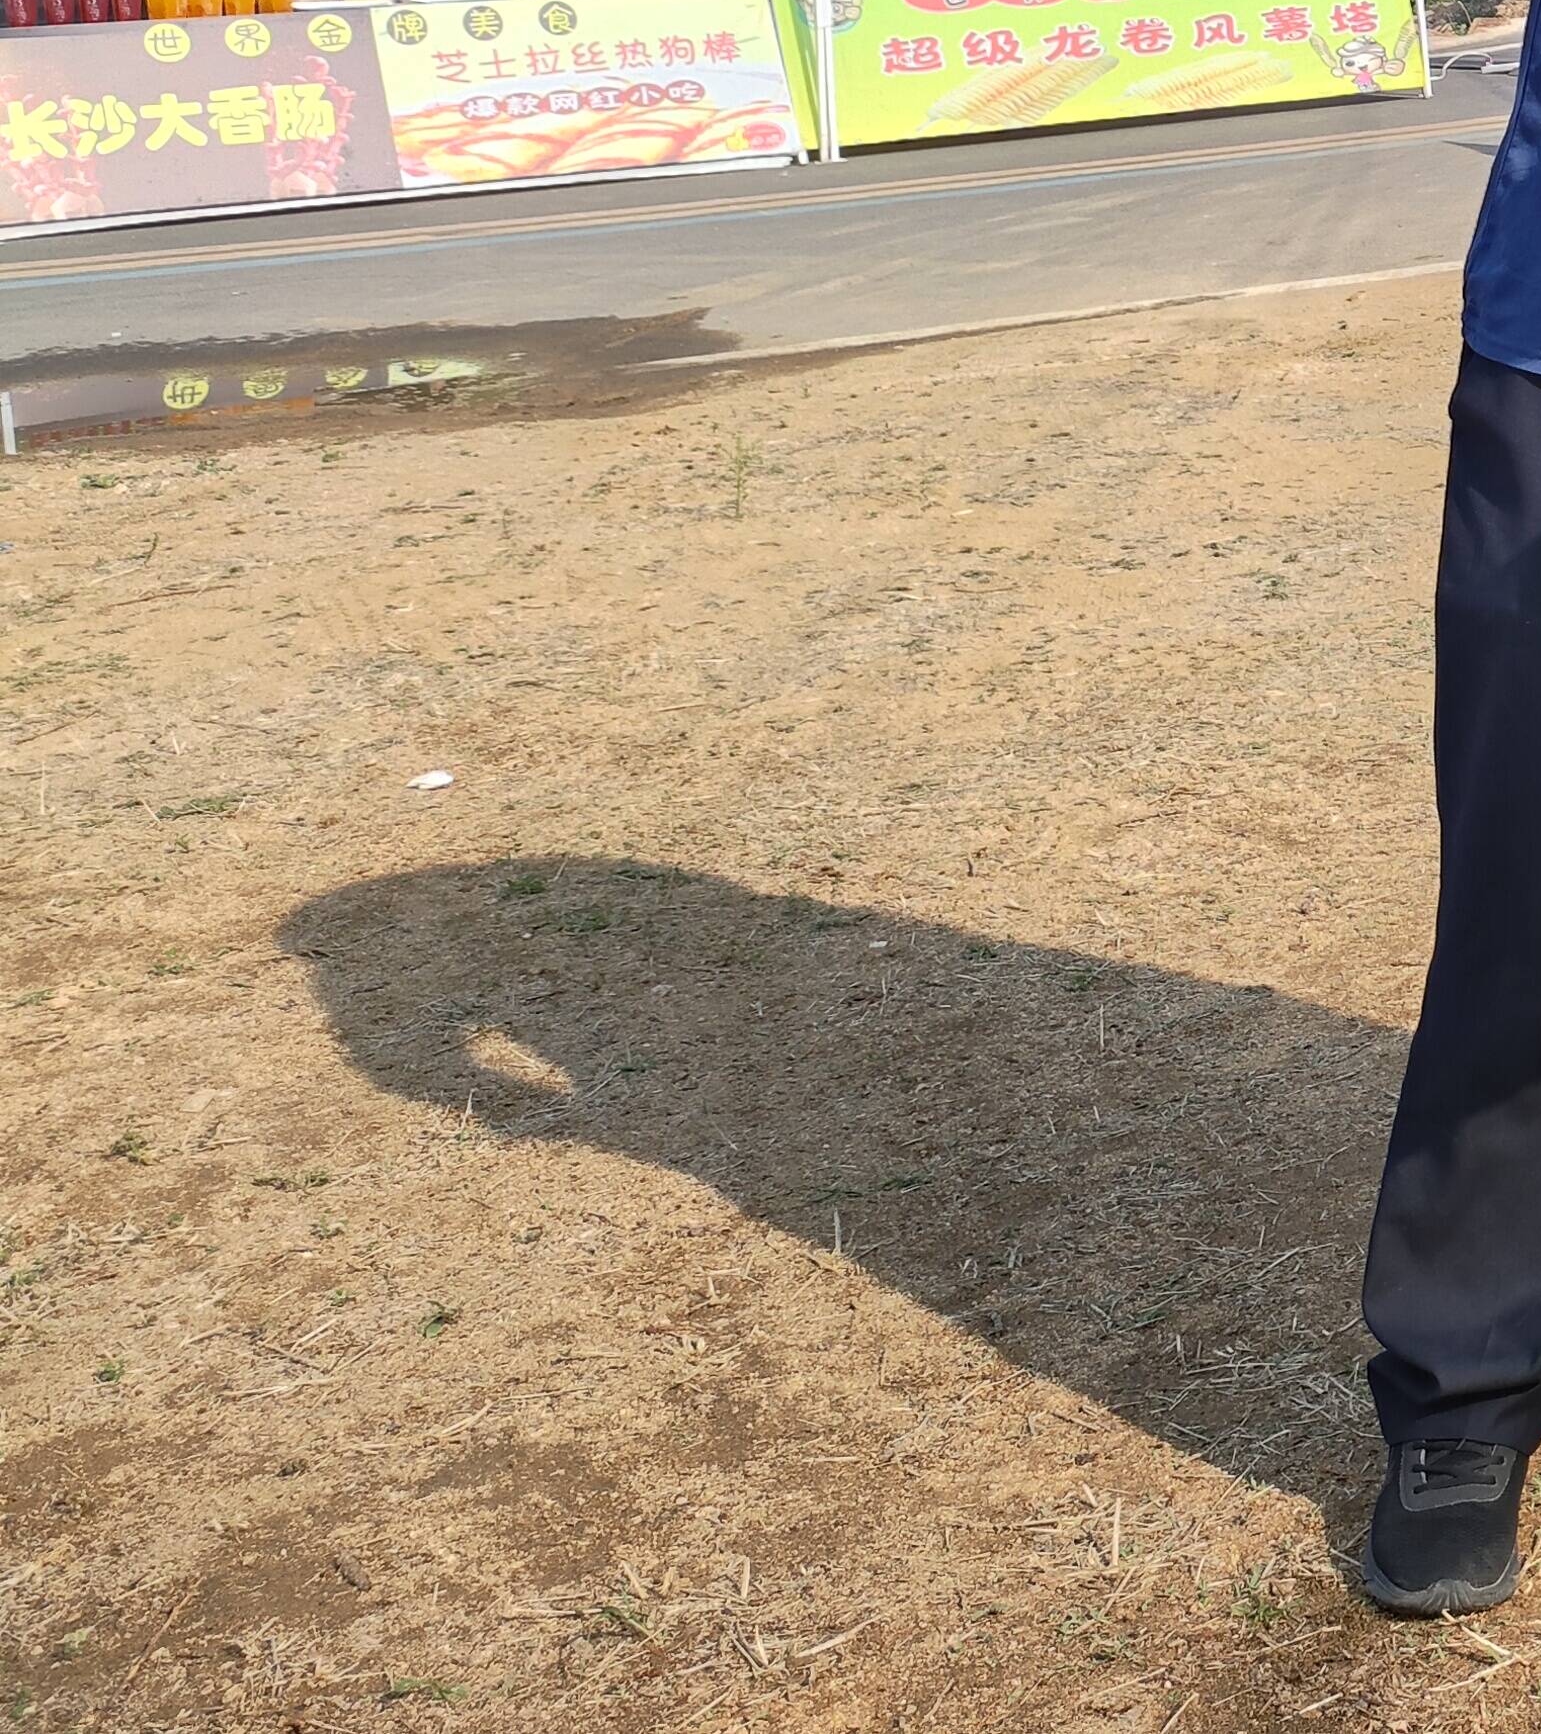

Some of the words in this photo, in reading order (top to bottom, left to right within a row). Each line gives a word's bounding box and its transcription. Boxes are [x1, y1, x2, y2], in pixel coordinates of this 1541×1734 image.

[149, 6, 576, 59] 世界金牌美食
[435, 32, 742, 83] 芝士拉丝热狗棒
[881, 0, 1380, 76] 超级龙卷风薯塔
[2, 81, 336, 162] 长沙大香肠
[464, 79, 702, 119] 爆款网红小吃
